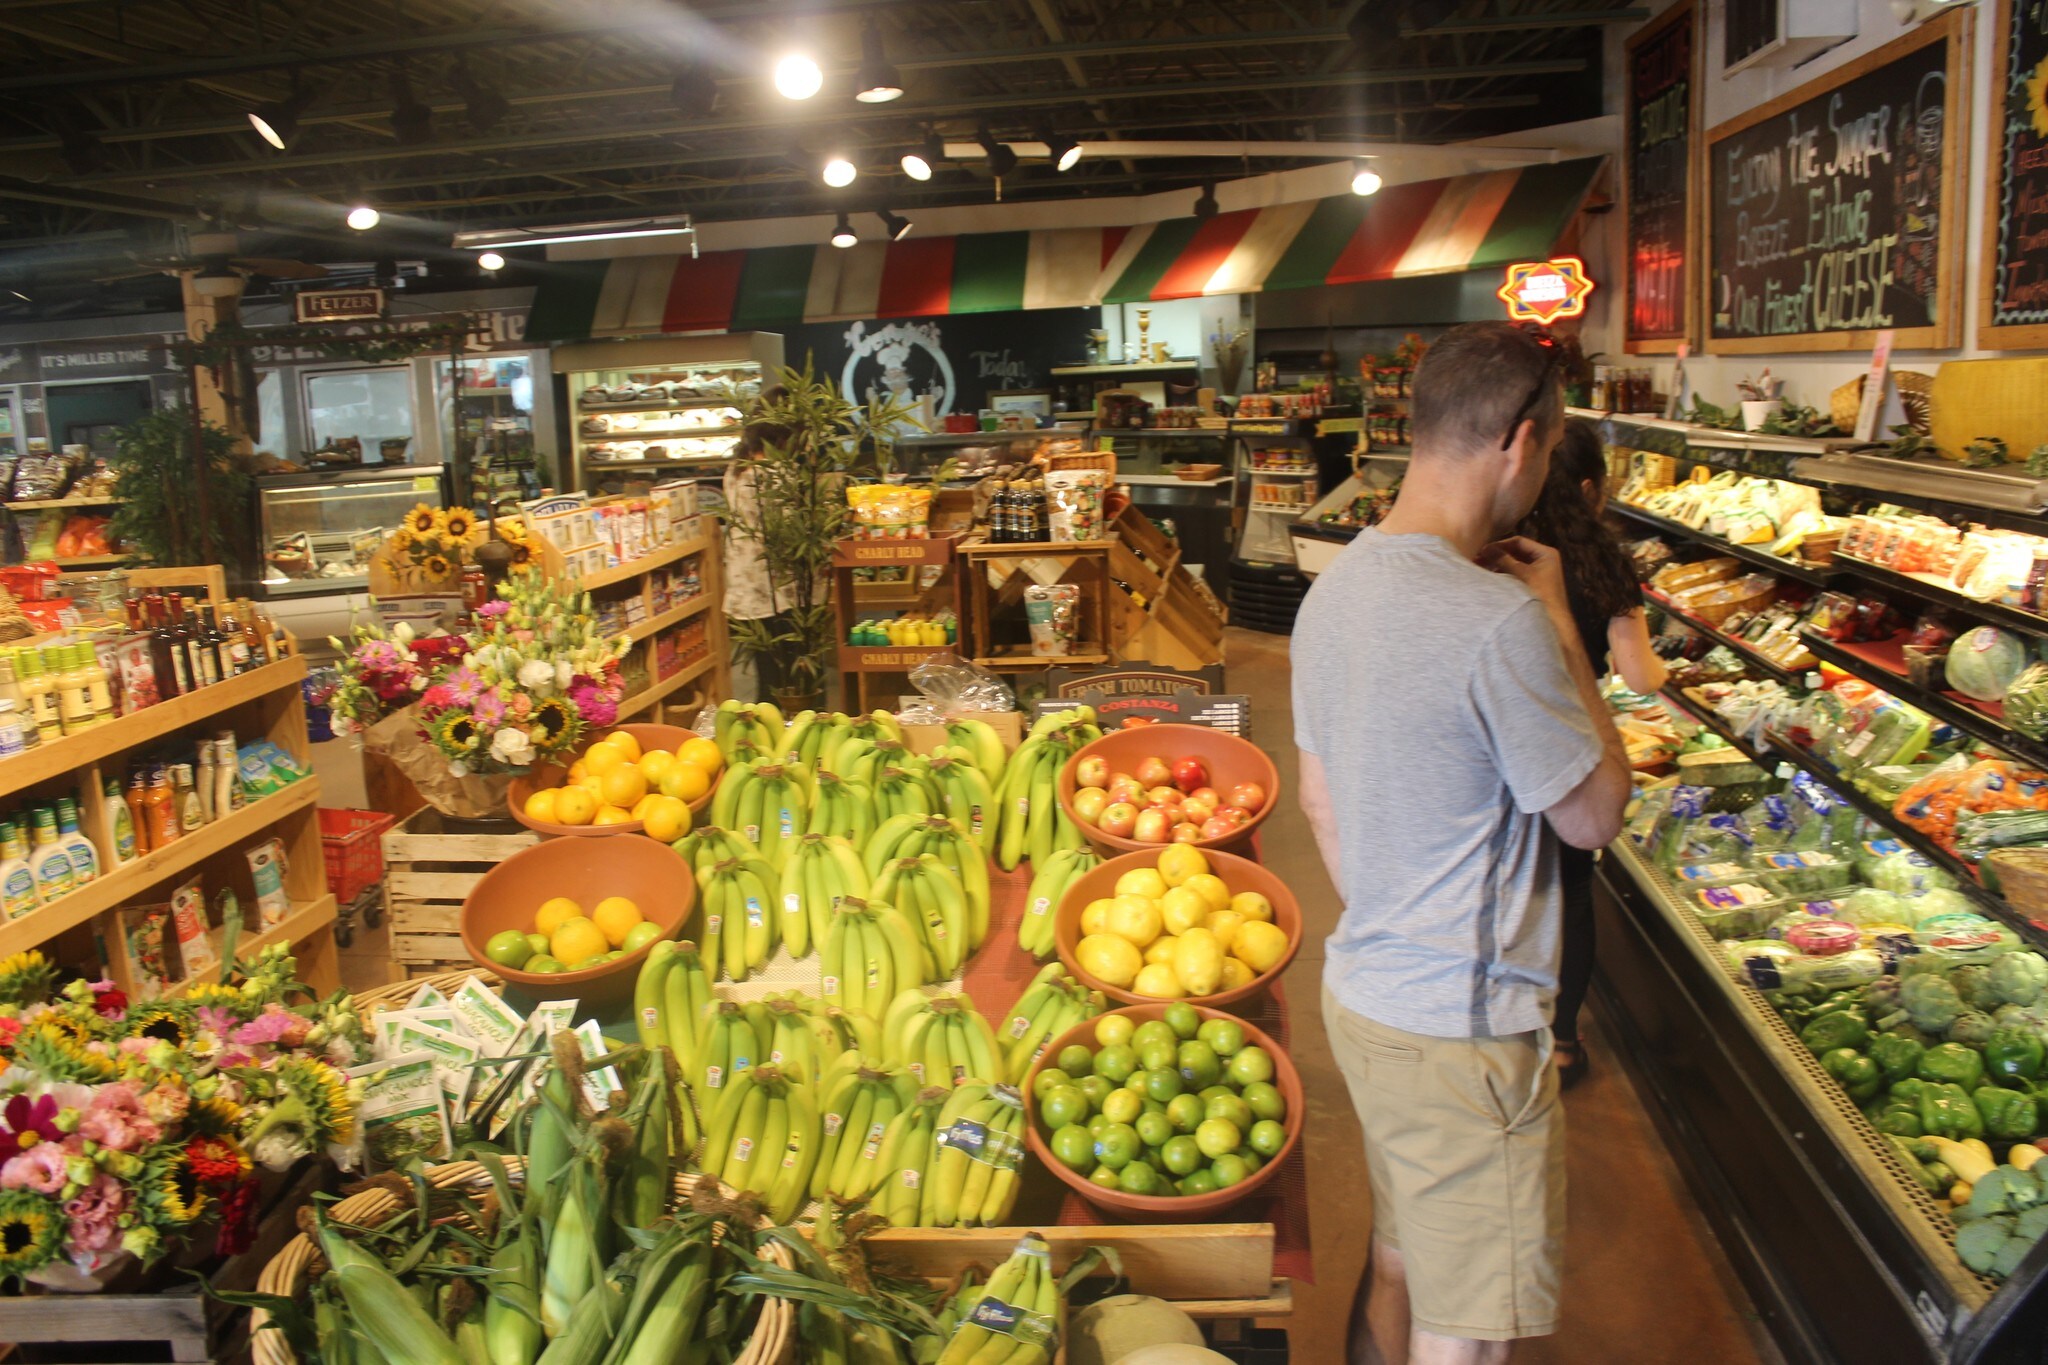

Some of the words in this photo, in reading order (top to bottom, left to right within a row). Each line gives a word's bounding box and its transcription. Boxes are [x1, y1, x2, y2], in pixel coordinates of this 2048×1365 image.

[310, 296, 373, 310] FETZER
[40, 354, 66, 368] IT'S
[67, 351, 116, 367] MILLER
[117, 349, 149, 363] TIME
[896, 546, 925, 558] HEAD
[1098, 700, 1179, 713] COSTANZA
